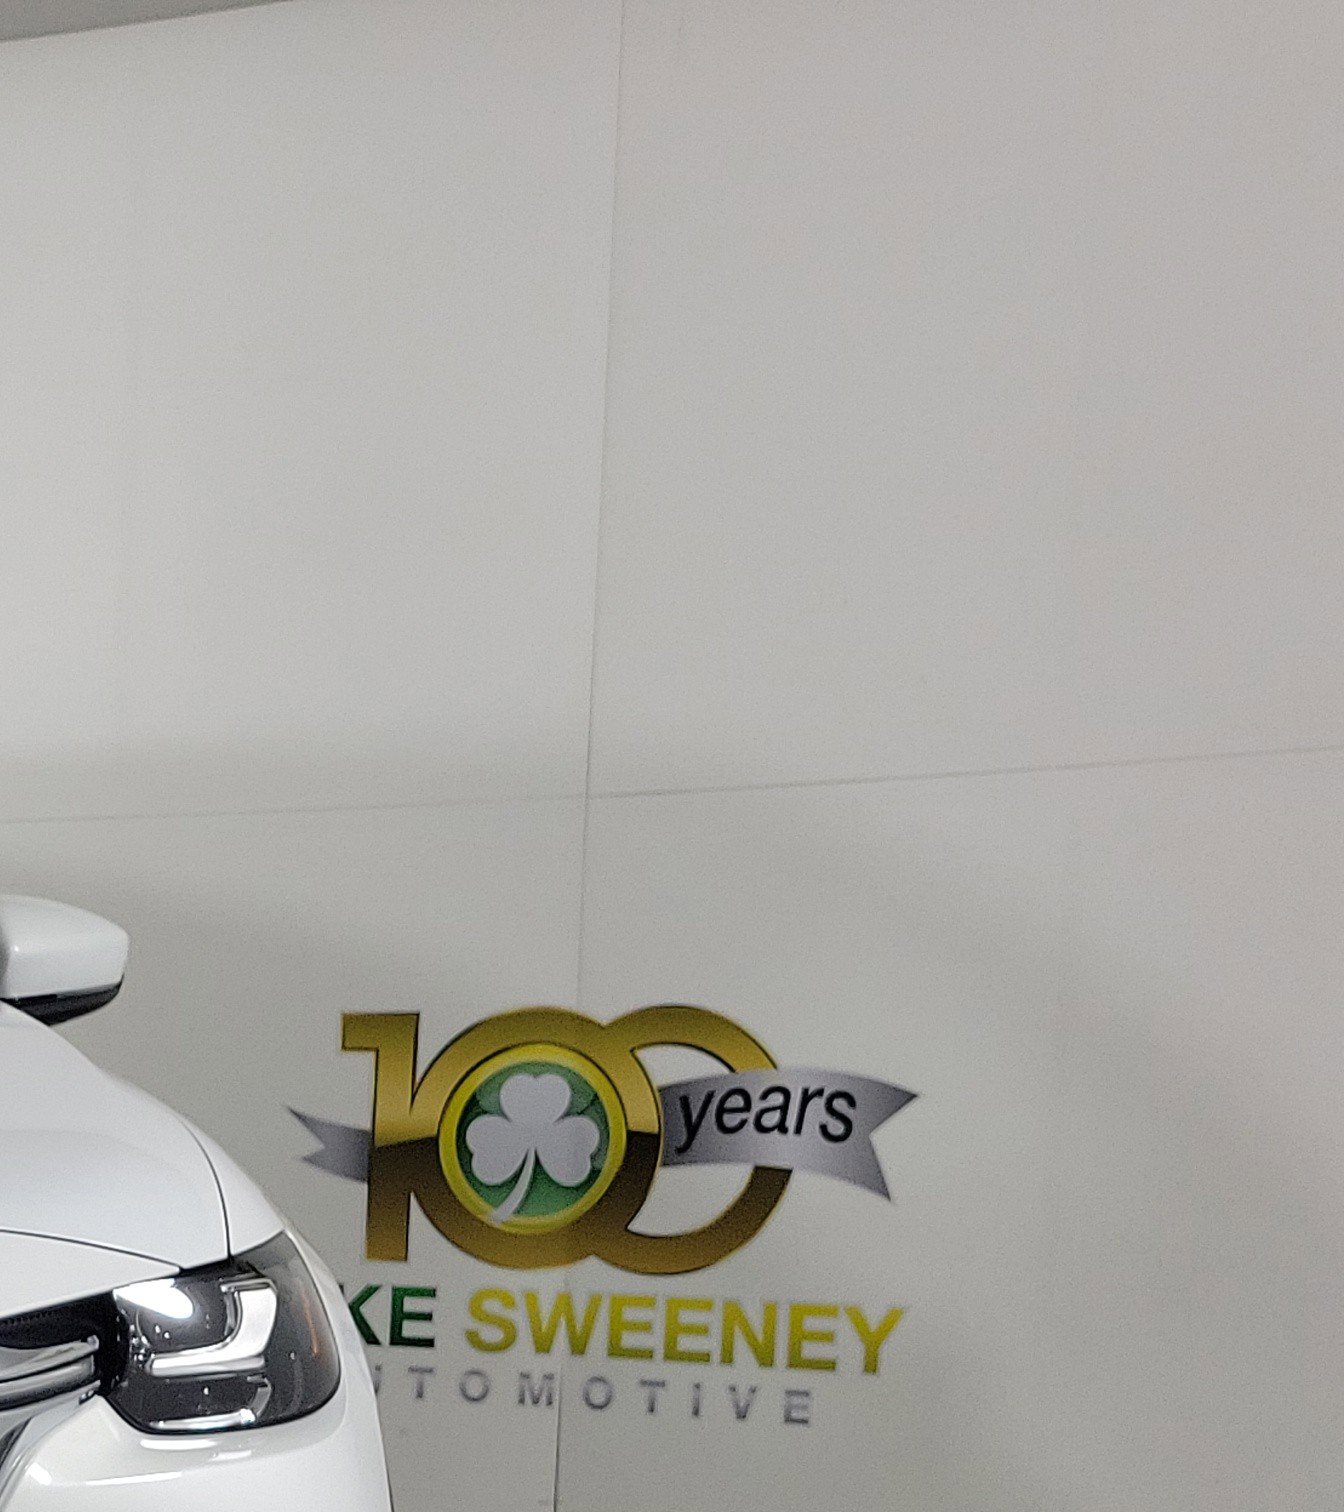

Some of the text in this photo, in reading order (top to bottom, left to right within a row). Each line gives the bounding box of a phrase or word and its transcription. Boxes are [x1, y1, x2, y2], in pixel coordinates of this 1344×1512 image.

[341, 1005, 857, 1275] 100 years
[339, 1284, 908, 1376] KE SWEENEY
[372, 1364, 813, 1426] TOMOTIVE
